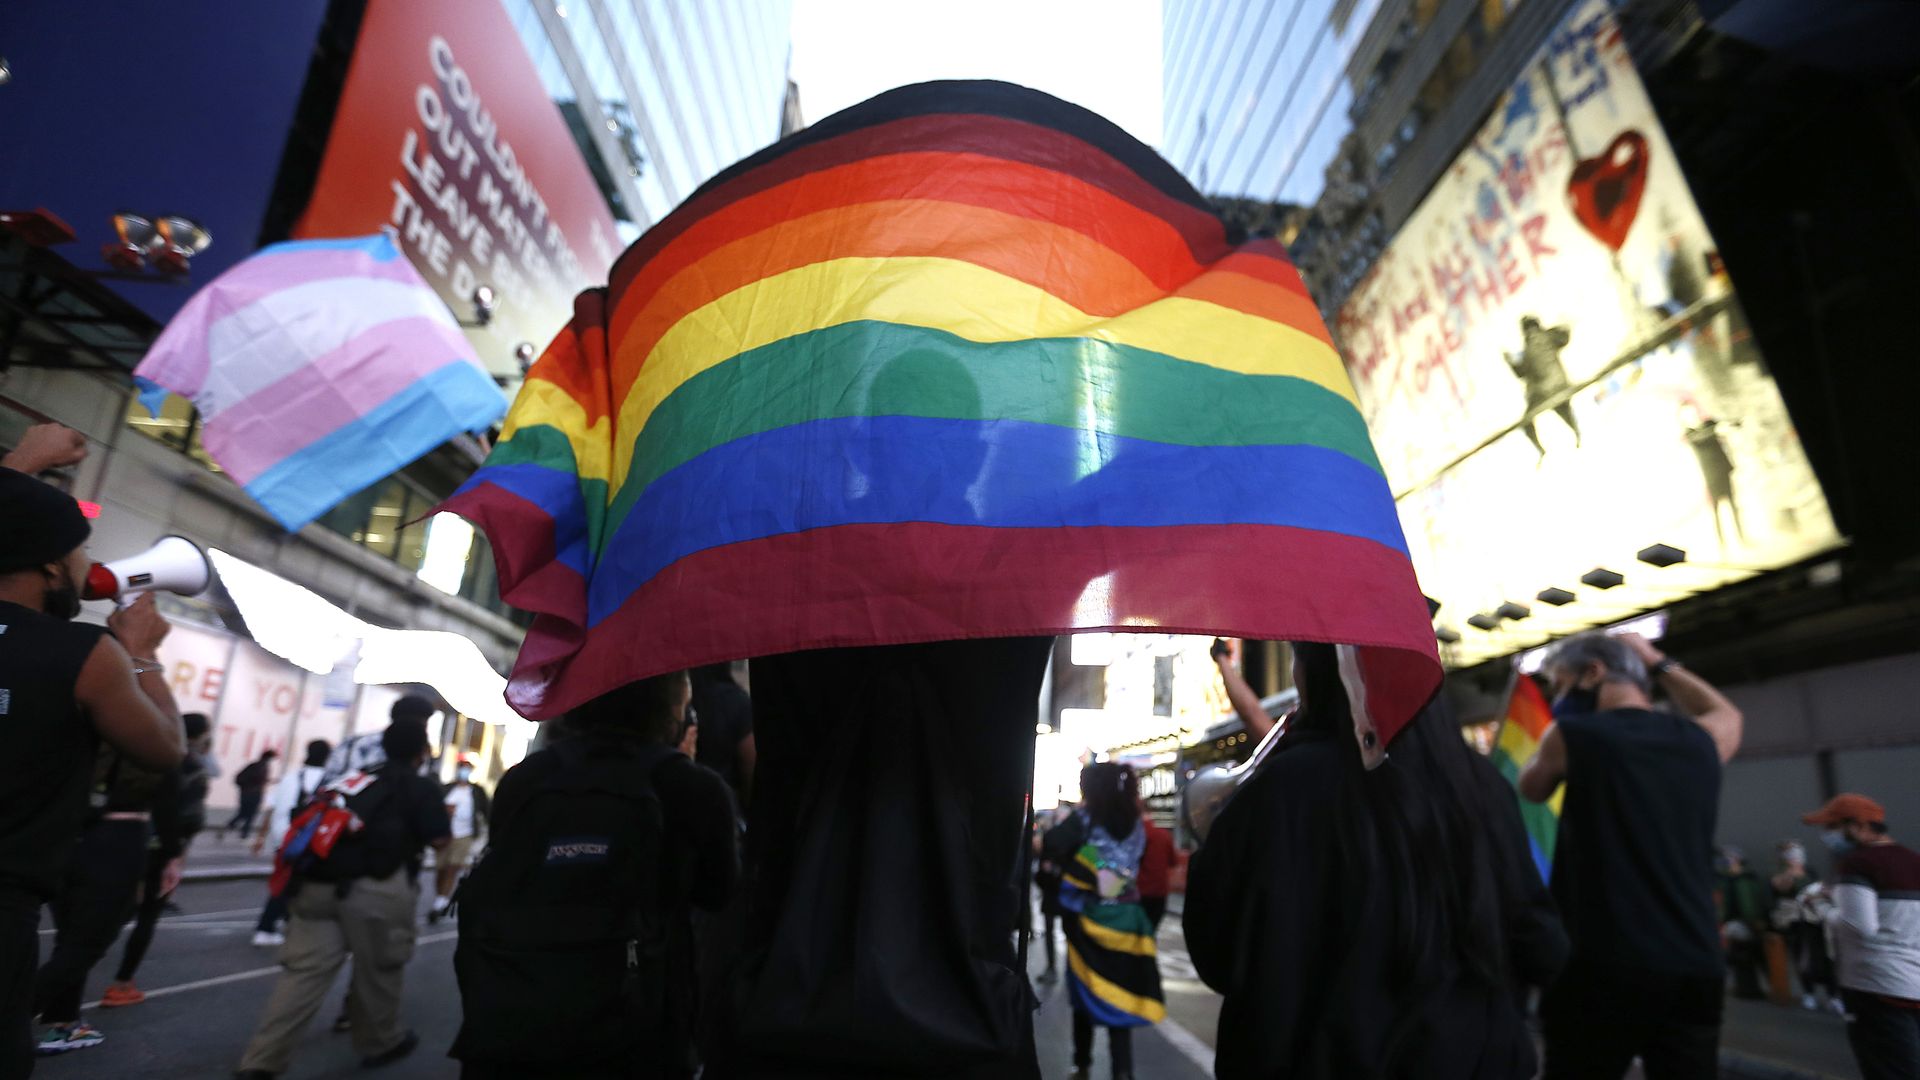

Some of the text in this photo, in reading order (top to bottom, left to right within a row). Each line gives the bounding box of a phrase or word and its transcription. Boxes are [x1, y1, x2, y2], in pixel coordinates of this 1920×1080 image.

[416, 84, 480, 180] OUT
[391, 180, 450, 277] THE
[402, 129, 493, 266] LEAVE
